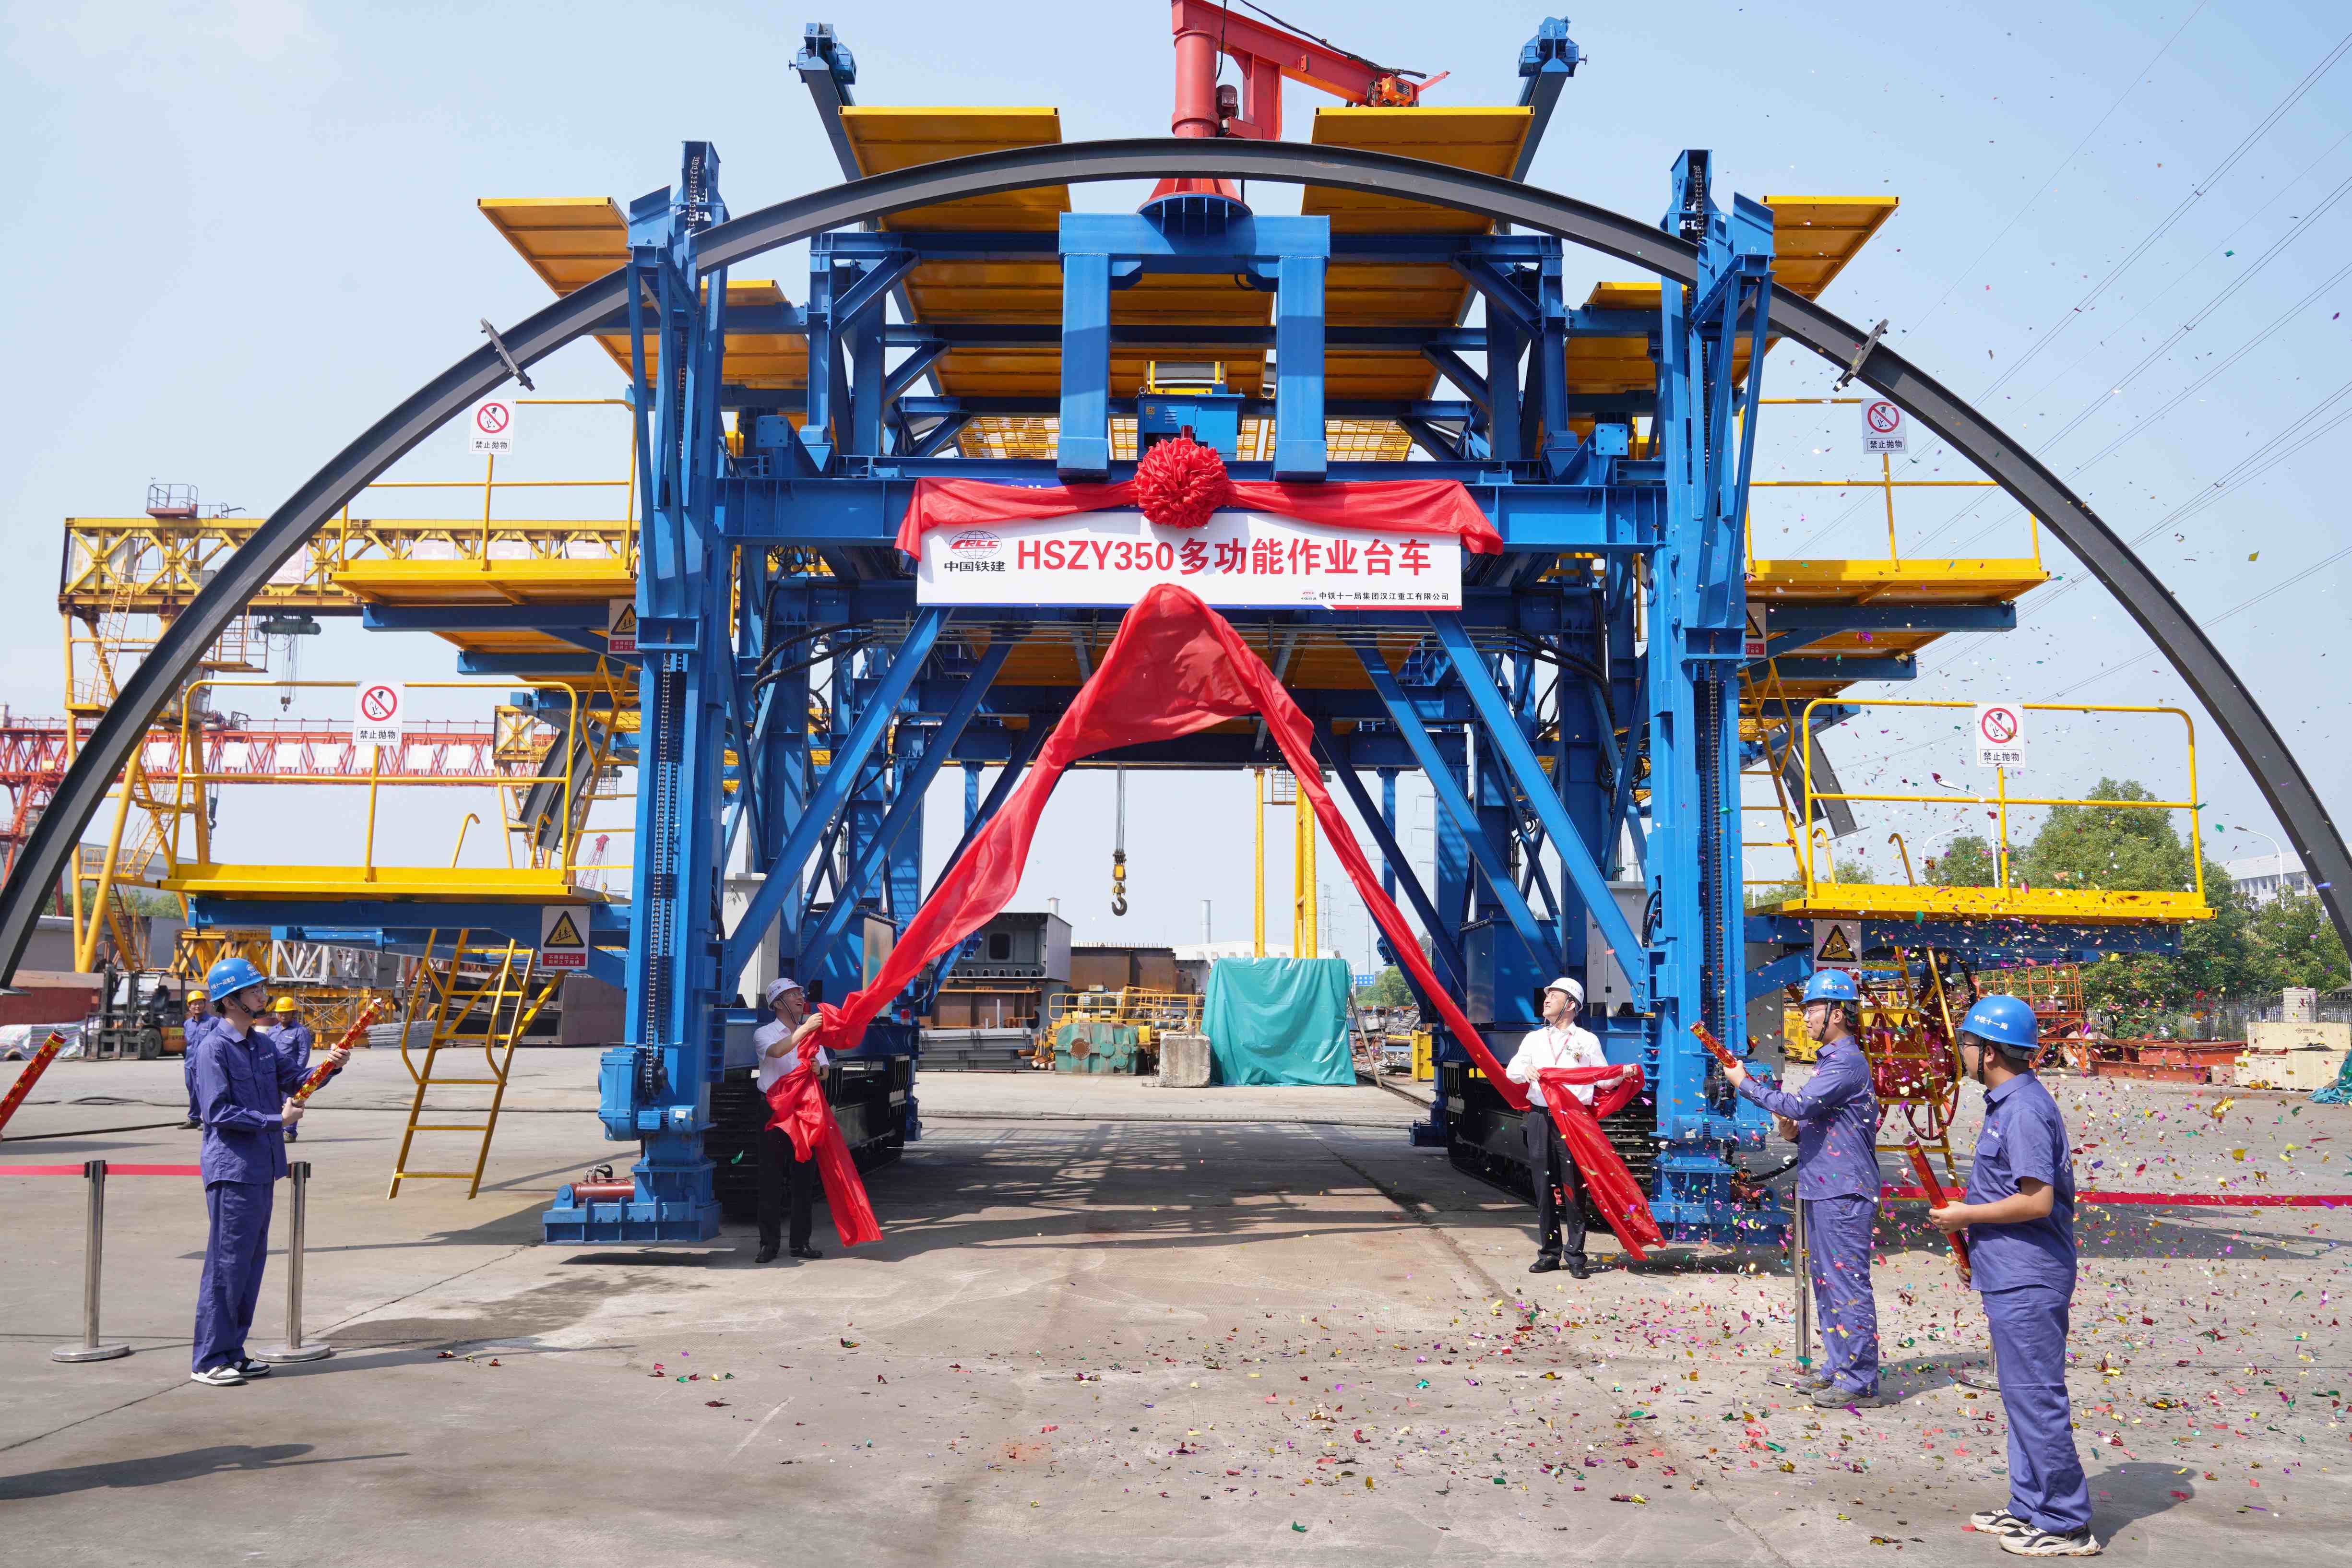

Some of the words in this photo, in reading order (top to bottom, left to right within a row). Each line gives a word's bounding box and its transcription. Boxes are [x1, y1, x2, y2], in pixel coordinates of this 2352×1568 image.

[475, 440, 508, 450] 禁止抛物
[1869, 440, 1902, 449] 禁止抛物
[1017, 537, 1431, 576] HSZY350多功能作业台车
[944, 560, 1006, 572] 中国铁建
[1319, 591, 1449, 601] 中铁十一局集团汉江重工有限公司
[360, 730, 396, 739] 禁止抛物
[1984, 751, 2019, 761] 禁止抛物
[1974, 1014, 2008, 1031] 中铁十一局
